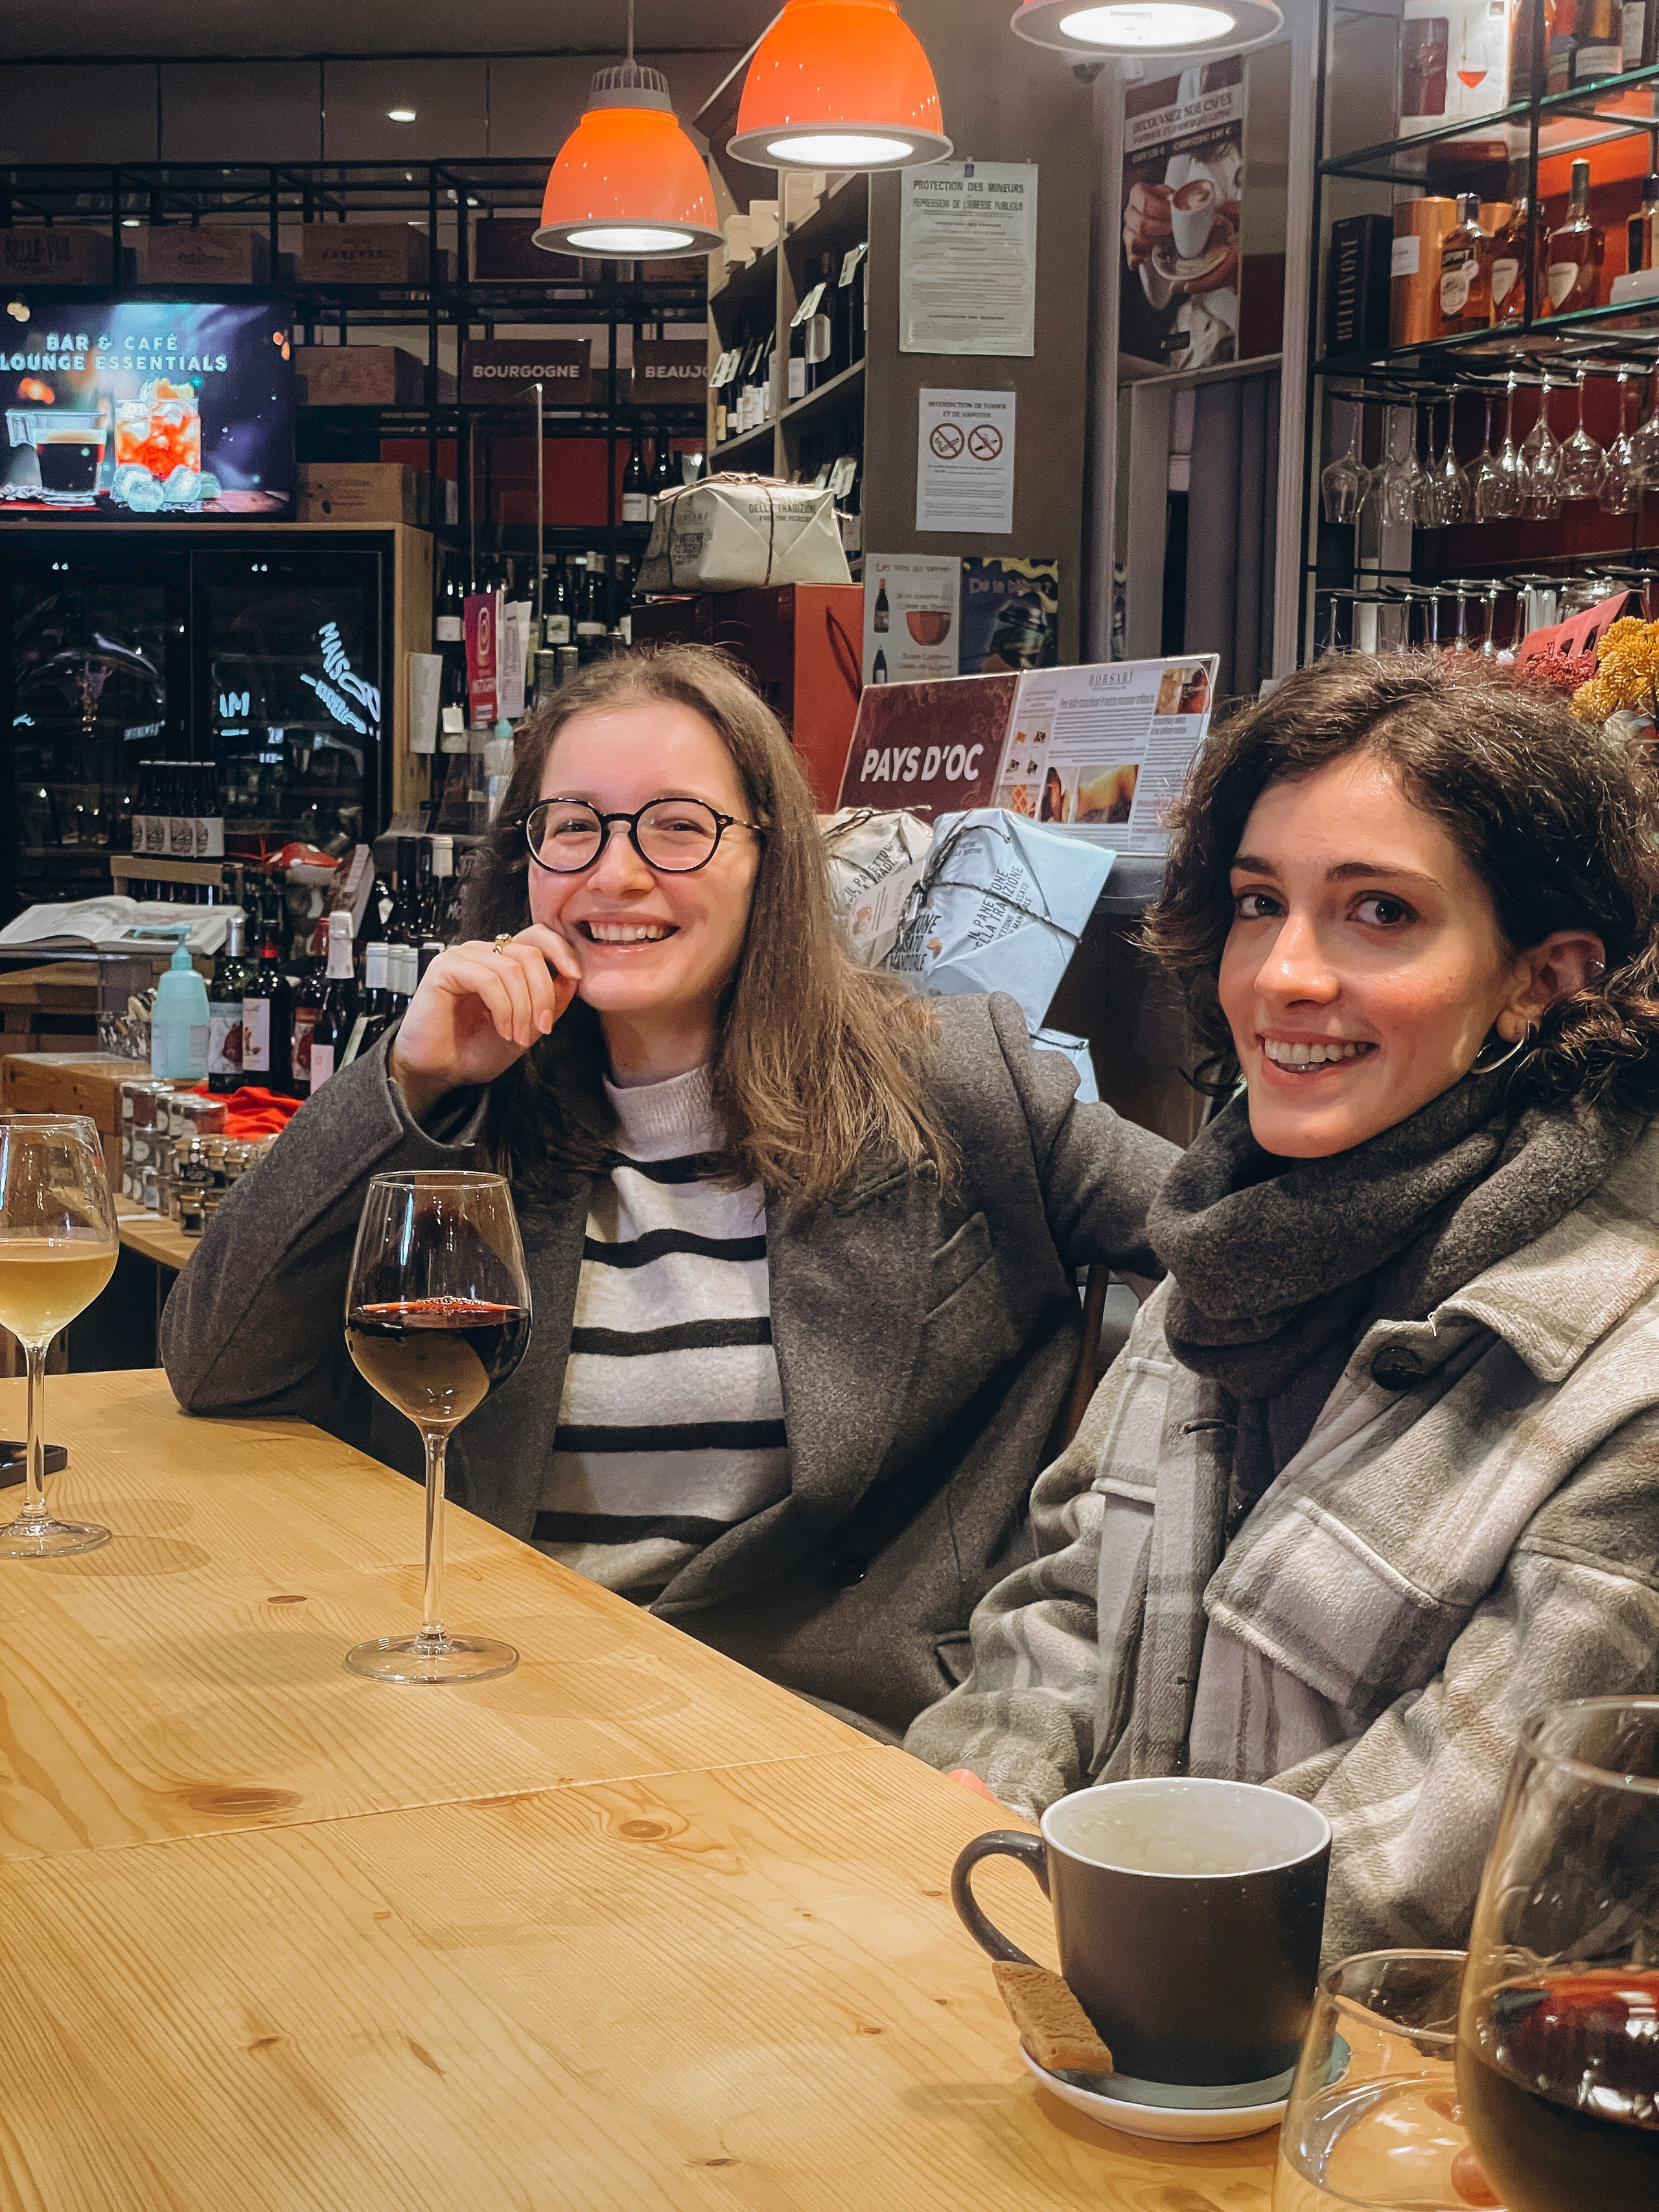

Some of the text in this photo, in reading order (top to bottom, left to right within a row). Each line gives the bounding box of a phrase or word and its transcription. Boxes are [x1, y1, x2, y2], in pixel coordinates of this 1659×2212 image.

[913, 180, 1024, 193] PROTECTION DES MINEURS
[46, 331, 179, 351] BAR & CAFÉ
[0, 353, 228, 372] LOUNGE ESSENTIALS
[472, 365, 580, 378] BOURGOGNE
[860, 743, 984, 782] PAYS D'OC
[990, 865, 1024, 922] TRAIZIONE
